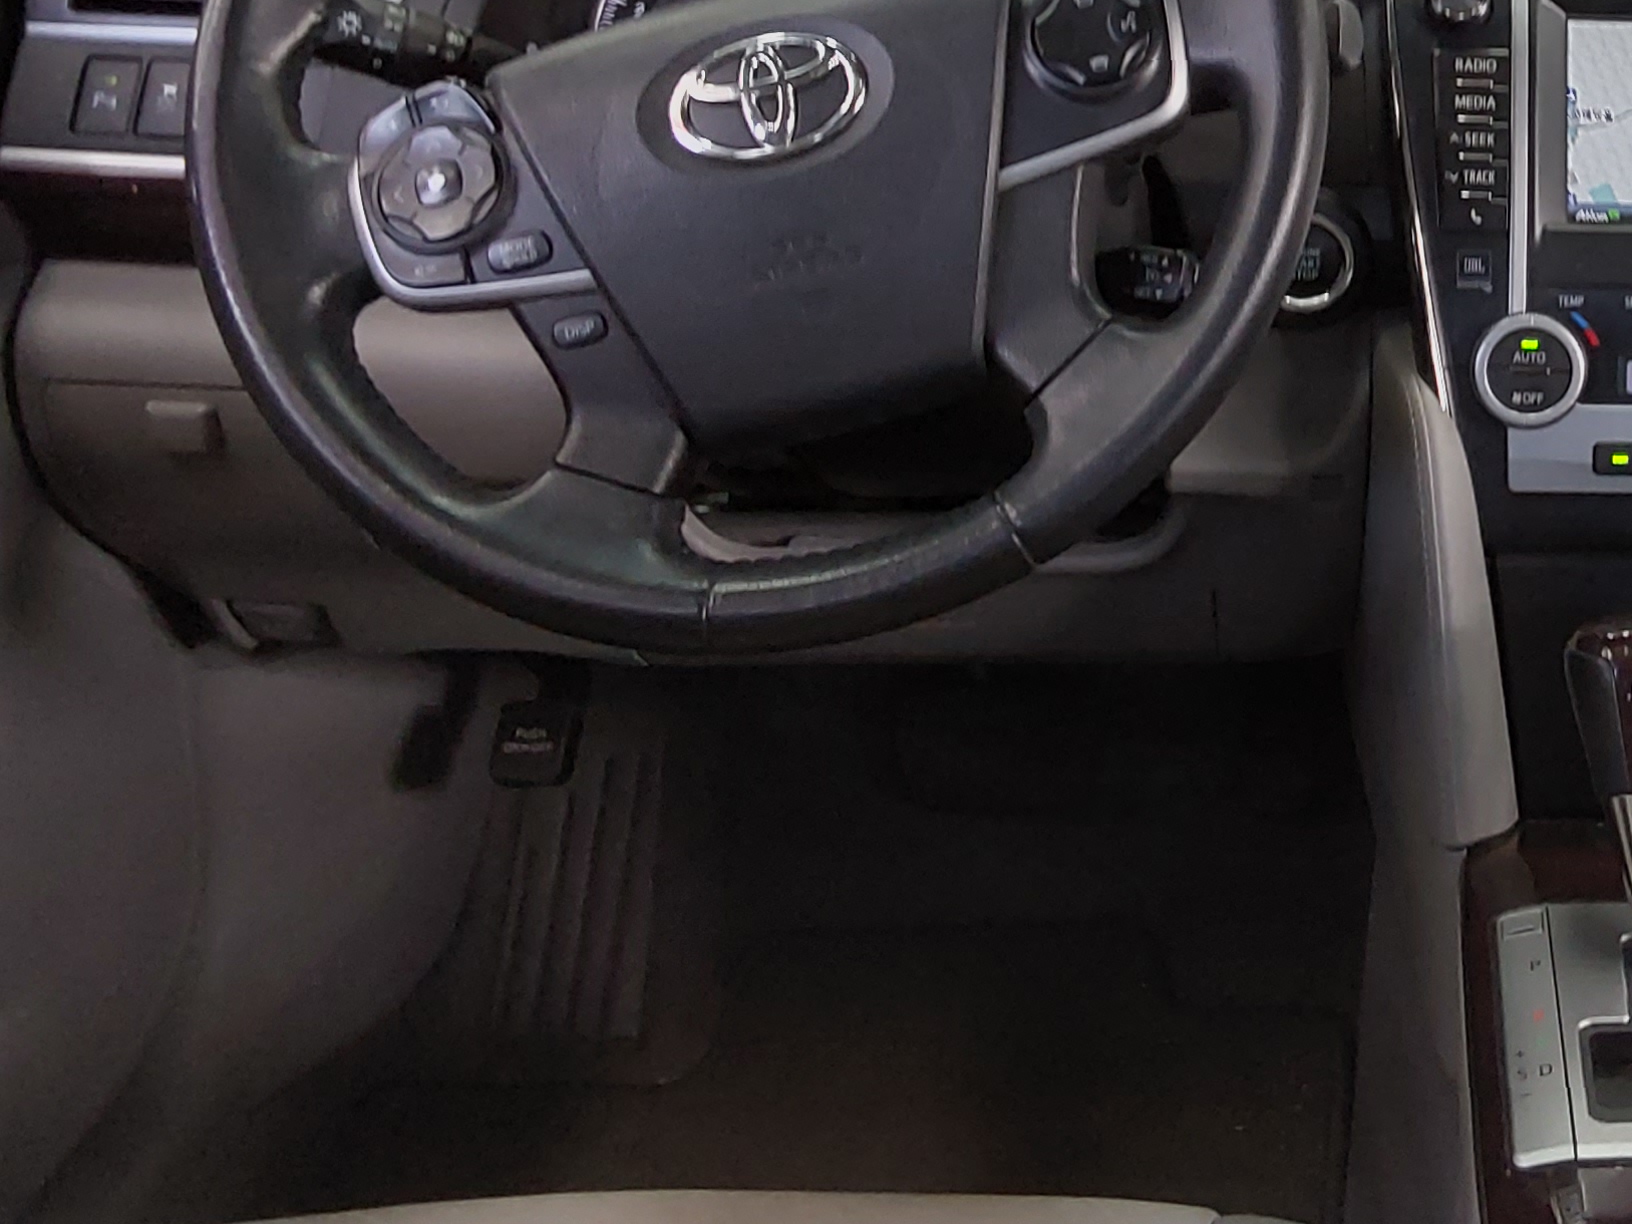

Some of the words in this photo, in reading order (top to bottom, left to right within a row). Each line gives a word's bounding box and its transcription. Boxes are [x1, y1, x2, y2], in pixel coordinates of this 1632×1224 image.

[1455, 57, 1497, 74] RADIO
[1454, 94, 1496, 111] MEDIA
[1464, 130, 1495, 148] SEEK
[1463, 168, 1495, 186] TRACK
[1558, 295, 1585, 309] TEMP
[1513, 351, 1546, 365] AUTO
[1523, 391, 1544, 404] OFF
[1539, 1063, 1553, 1076] D
